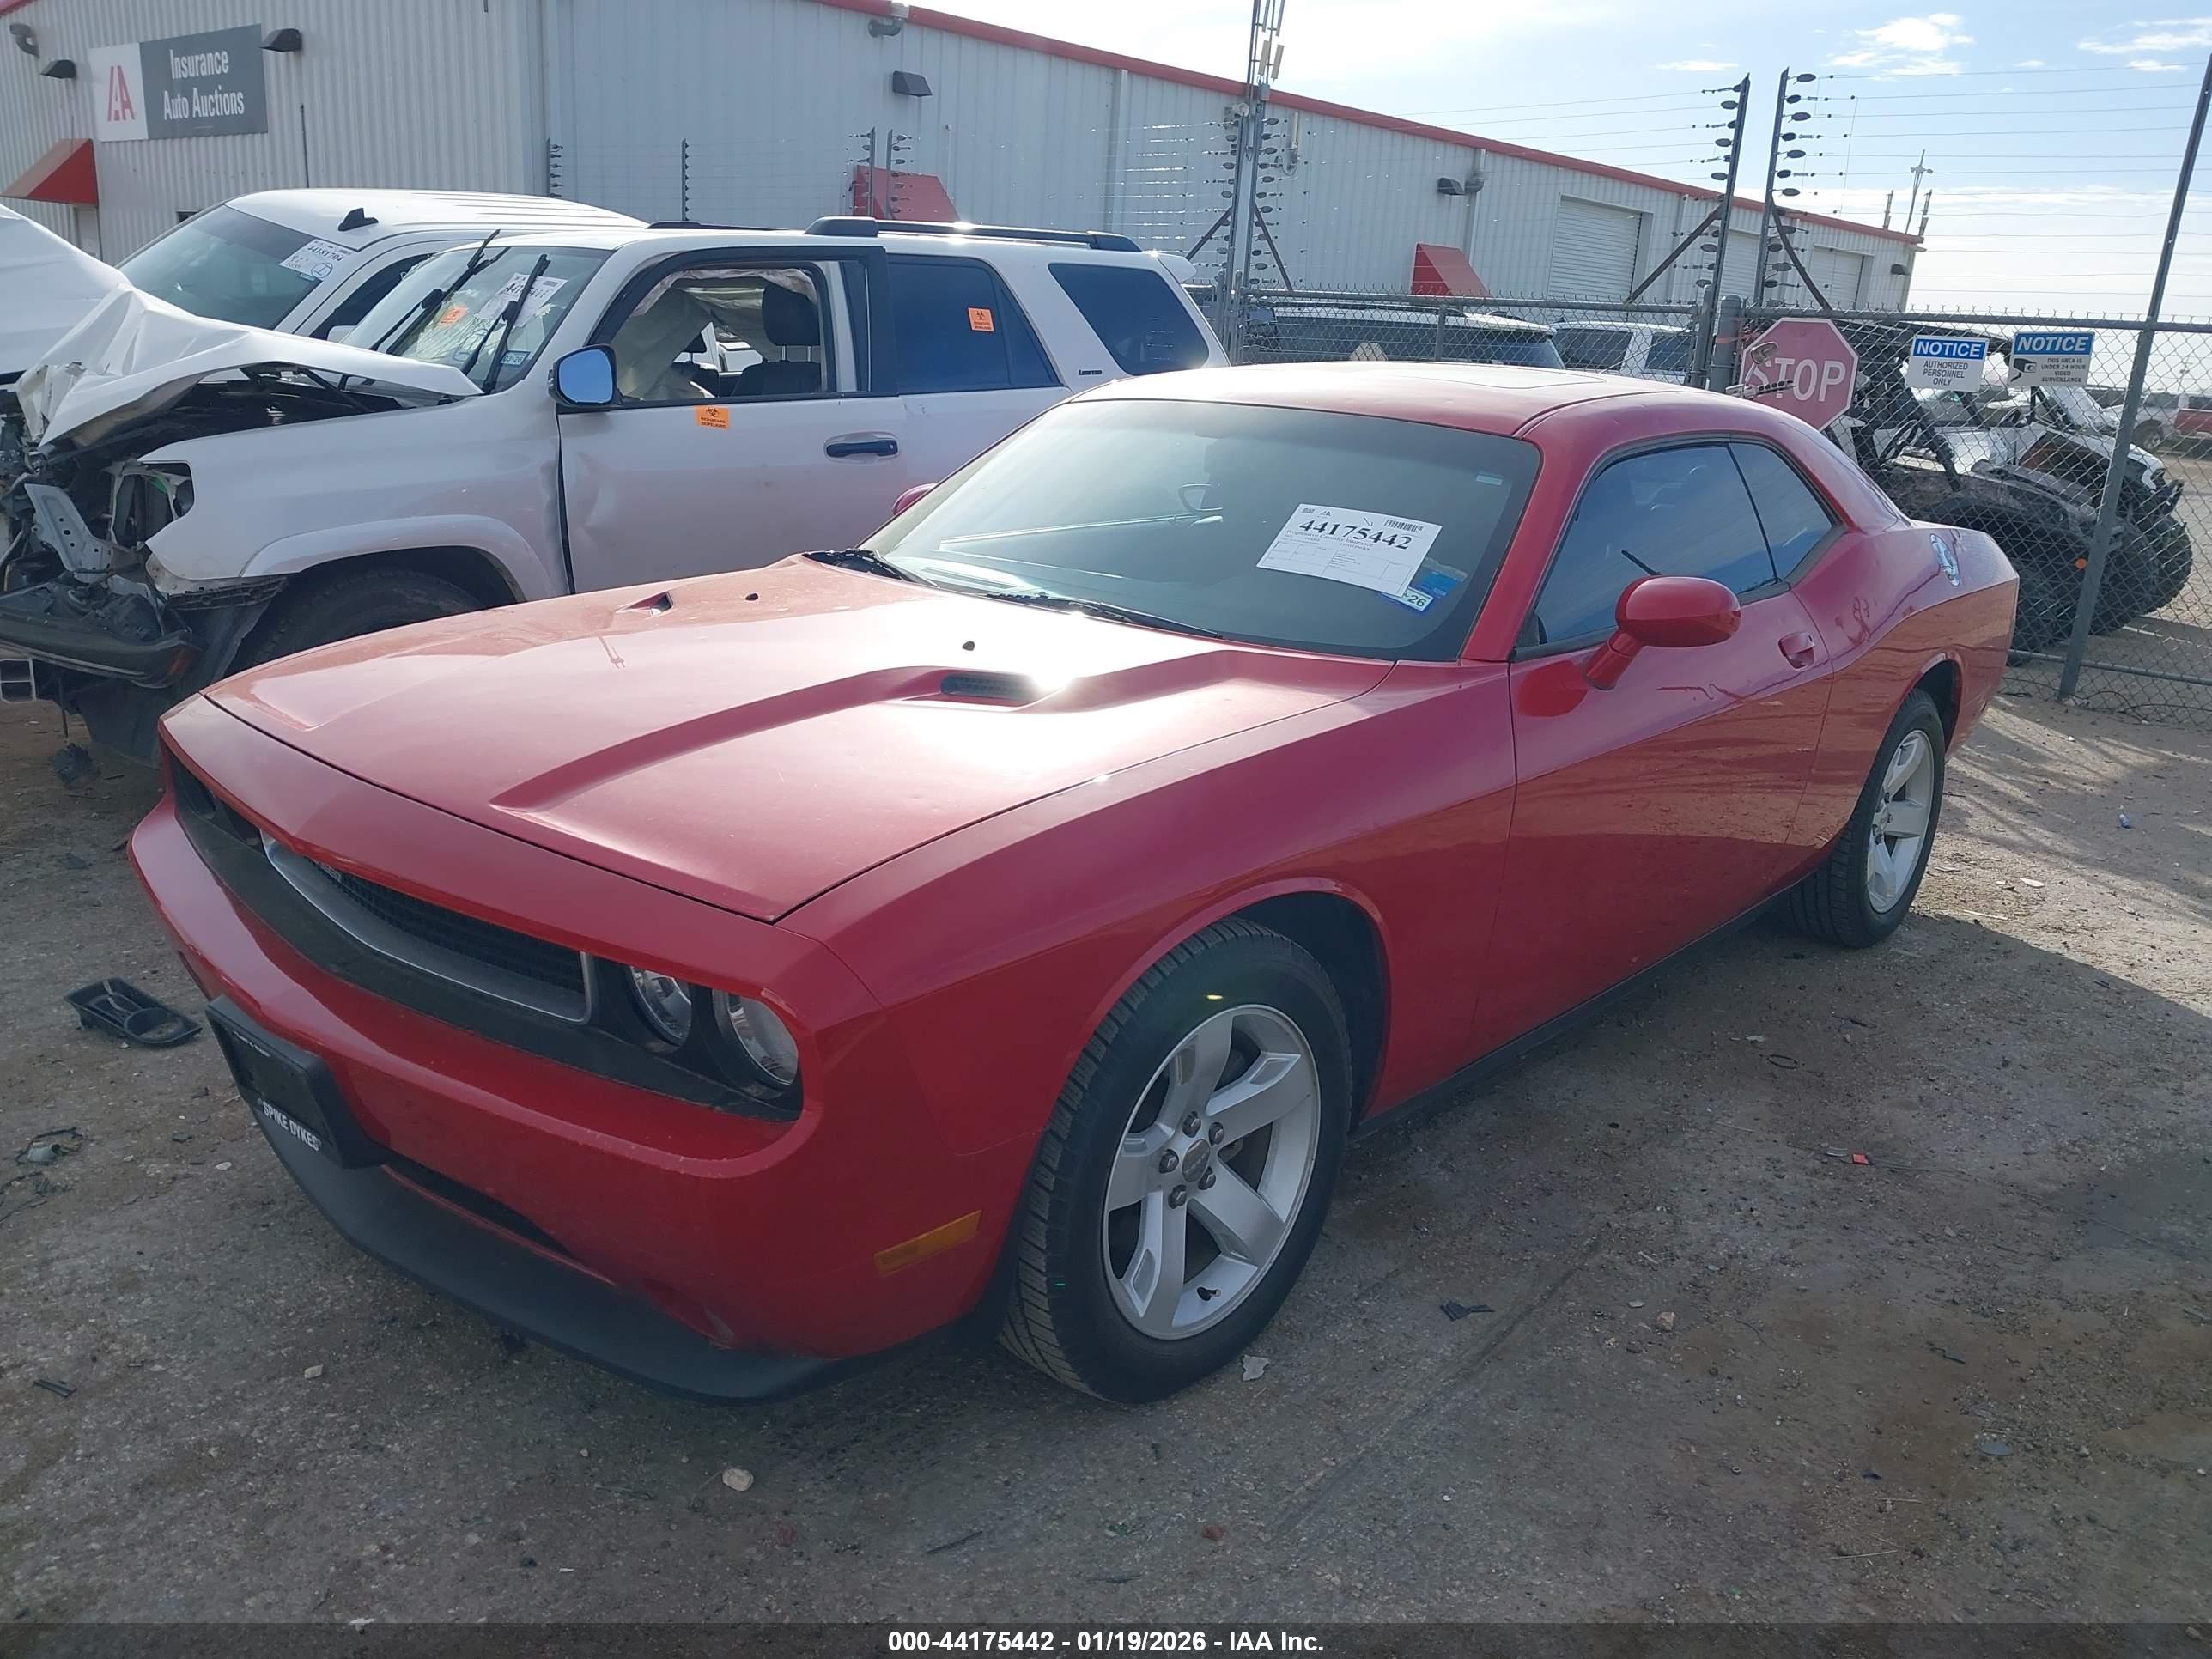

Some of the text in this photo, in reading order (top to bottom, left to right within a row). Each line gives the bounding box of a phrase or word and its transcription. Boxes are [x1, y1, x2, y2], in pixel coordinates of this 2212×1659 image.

[170, 49, 228, 79] Insurance
[164, 85, 245, 120] Auto Auctions
[1917, 341, 1982, 357] NOTICE
[2017, 336, 2089, 352] NOTICE
[1923, 360, 1969, 370] AUTHORIZED
[1923, 368, 1965, 379] PERSONNEL
[1932, 378, 1953, 386] ONLY
[1298, 520, 1413, 550] 44175442
[262, 1100, 320, 1152] SPIKE DYKES
